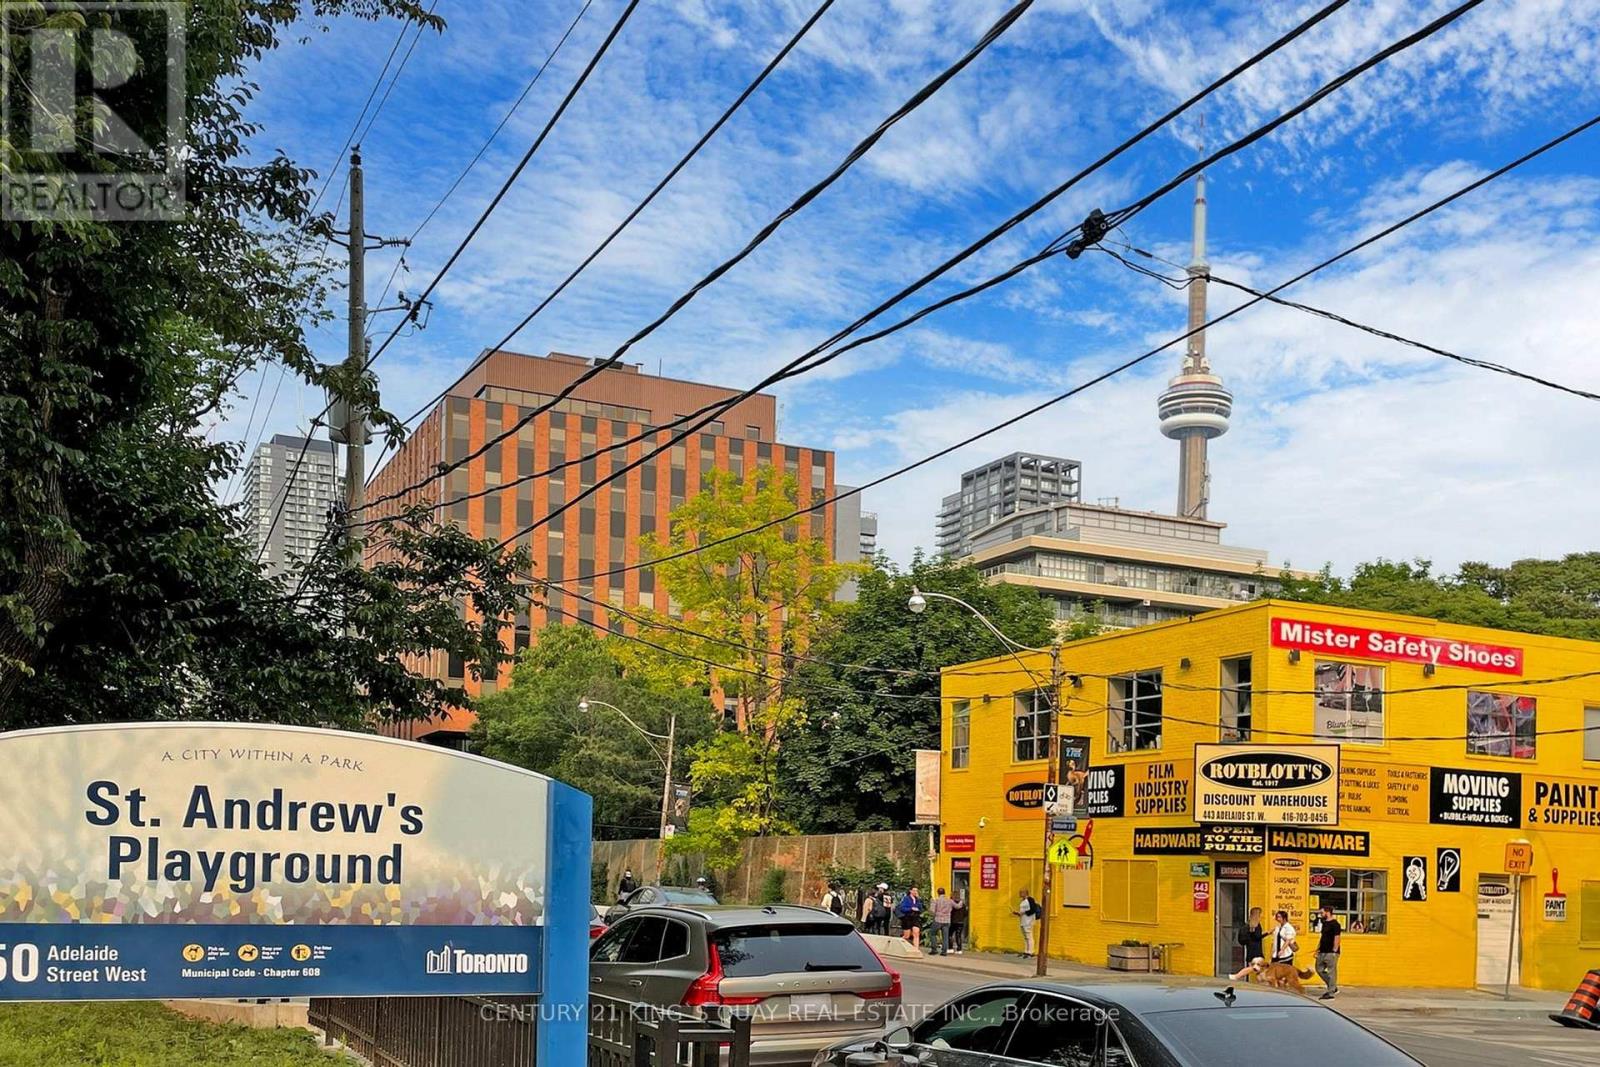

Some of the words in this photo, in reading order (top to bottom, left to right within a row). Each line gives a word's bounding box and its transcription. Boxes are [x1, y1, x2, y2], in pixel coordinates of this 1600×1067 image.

[1280, 622, 1360, 649] Mister
[1367, 632, 1441, 663] Safety
[1449, 644, 1516, 668] Shoes
[162, 750, 174, 761] A
[182, 749, 221, 761] CITY
[229, 749, 294, 762] WITHIN
[301, 754, 312, 764] A
[320, 755, 364, 771] PARK
[1148, 764, 1174, 779] FILM
[1210, 763, 1323, 780] ROTBLOTT'S
[1088, 770, 1115, 790] VING
[1443, 773, 1510, 798] MOVING
[1088, 790, 1109, 804] PLIES
[1134, 780, 1189, 798] INDUSTRY
[1535, 782, 1599, 809] PAINT
[86, 781, 160, 827] St.
[183, 785, 423, 834] Andrew's
[1135, 798, 1187, 815] SUPPLIES
[1204, 794, 1257, 806] DISCOUNT
[1262, 794, 1328, 808] WAREHOUSE
[1452, 796, 1502, 813] SUPPLIES
[1203, 810, 1215, 820] 443
[1216, 811, 1245, 821] ADELAIDE
[1282, 812, 1328, 823] 416-703-0456
[1528, 808, 1538, 824] &
[1212, 826, 1254, 834] OPEN
[1204, 834, 1225, 843] TO
[1229, 835, 1263, 843] THE
[1273, 831, 1365, 851] HARDWARE
[1204, 843, 1263, 852] PUBLIC
[1513, 848, 1524, 857] NO
[108, 836, 402, 894] Playground
[1221, 867, 1248, 875] ENTRANCE
[1509, 861, 1526, 869] EXIT
[1194, 883, 1209, 892] 443
[1311, 876, 1333, 886] OPEN
[1545, 900, 1566, 910] PAINT
[47, 945, 119, 961] Adelaide
[0, 943, 39, 982] 0
[454, 950, 528, 973] TORONTO
[47, 967, 99, 982] Street
[105, 966, 147, 982] West
[182, 968, 229, 979] Municipal
[232, 968, 256, 977] Code
[264, 968, 300, 978] Chapter
[302, 968, 320, 977] 608
